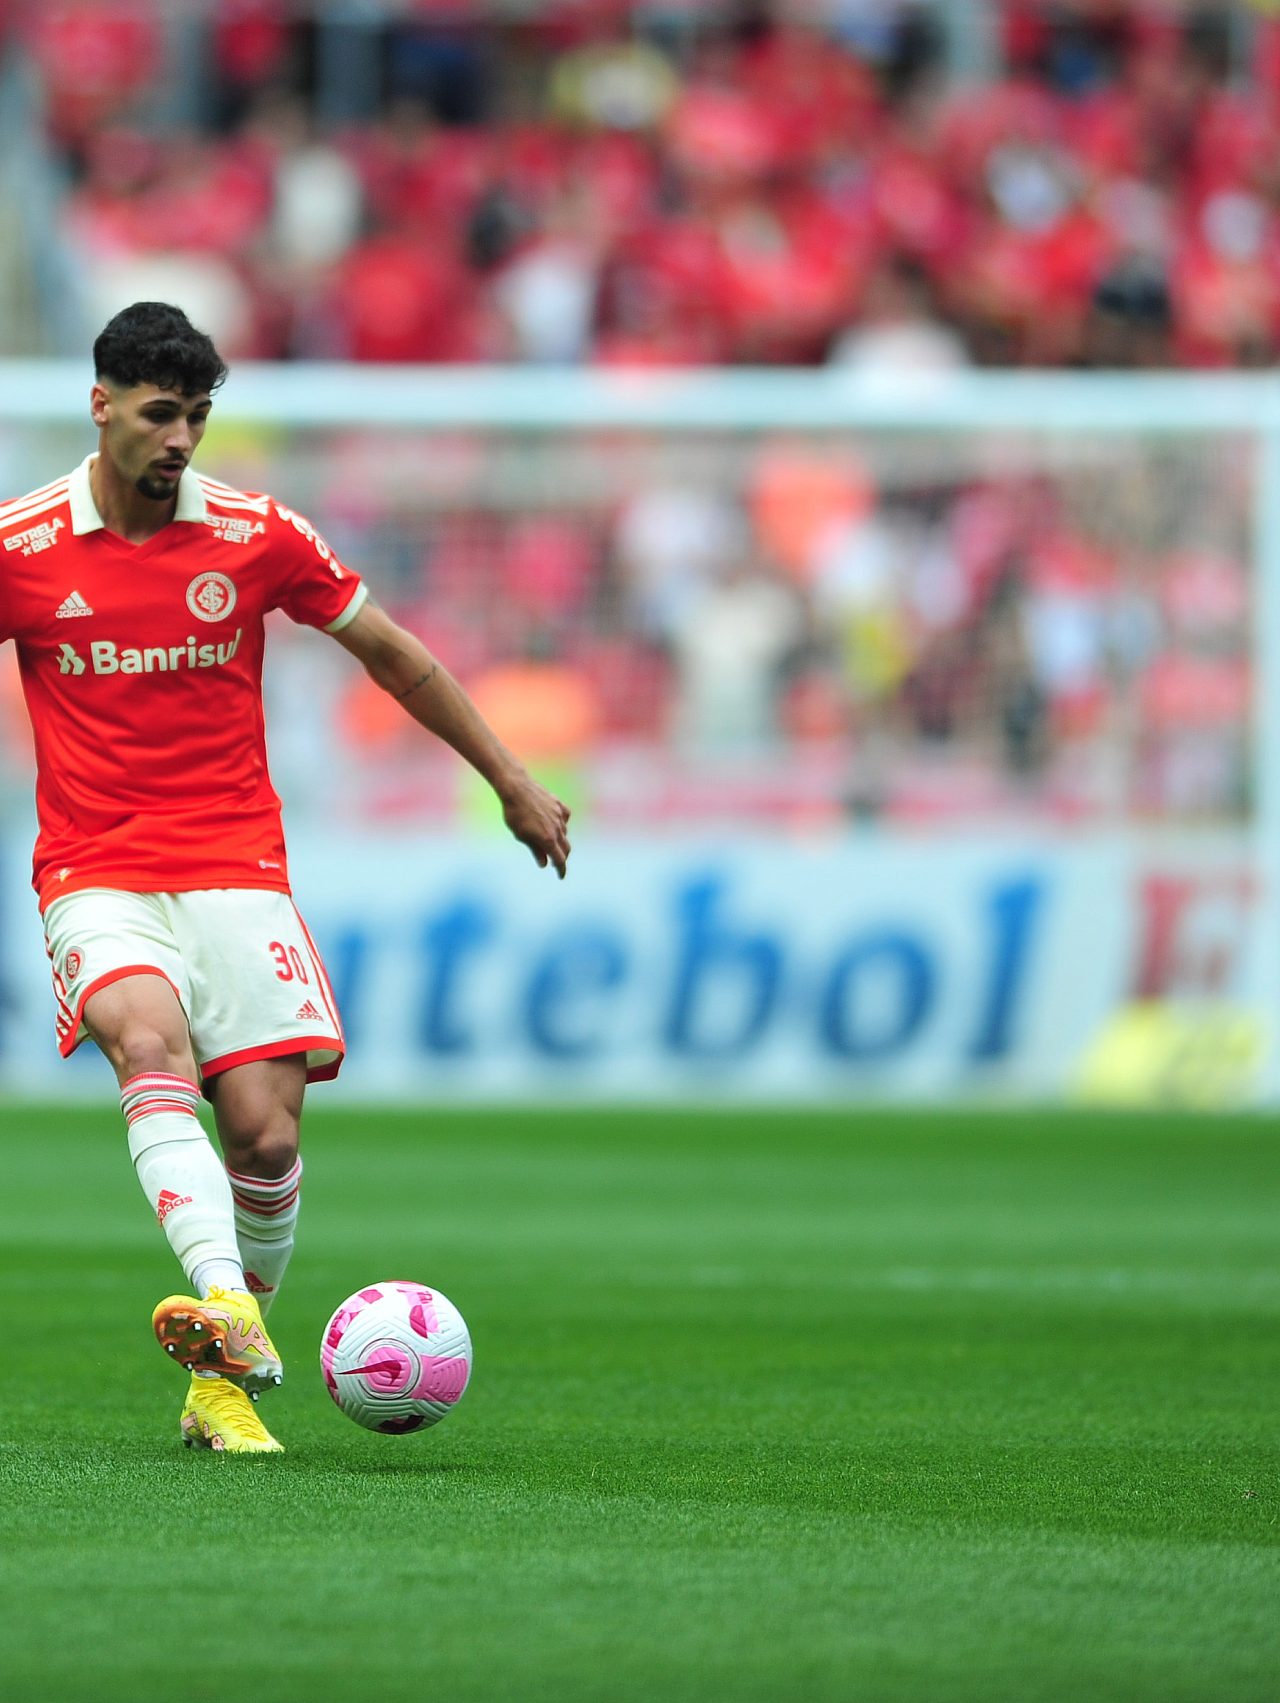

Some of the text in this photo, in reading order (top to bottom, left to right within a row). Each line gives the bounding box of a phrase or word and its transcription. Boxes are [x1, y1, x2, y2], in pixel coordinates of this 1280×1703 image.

[3, 517, 65, 551] ESTRELA
[205, 514, 265, 534] ESTRELA
[30, 531, 58, 553] BET
[222, 529, 253, 544] BET
[55, 607, 94, 619] adidas
[90, 628, 242, 675] Banrisul
[268, 941, 309, 986] 30
